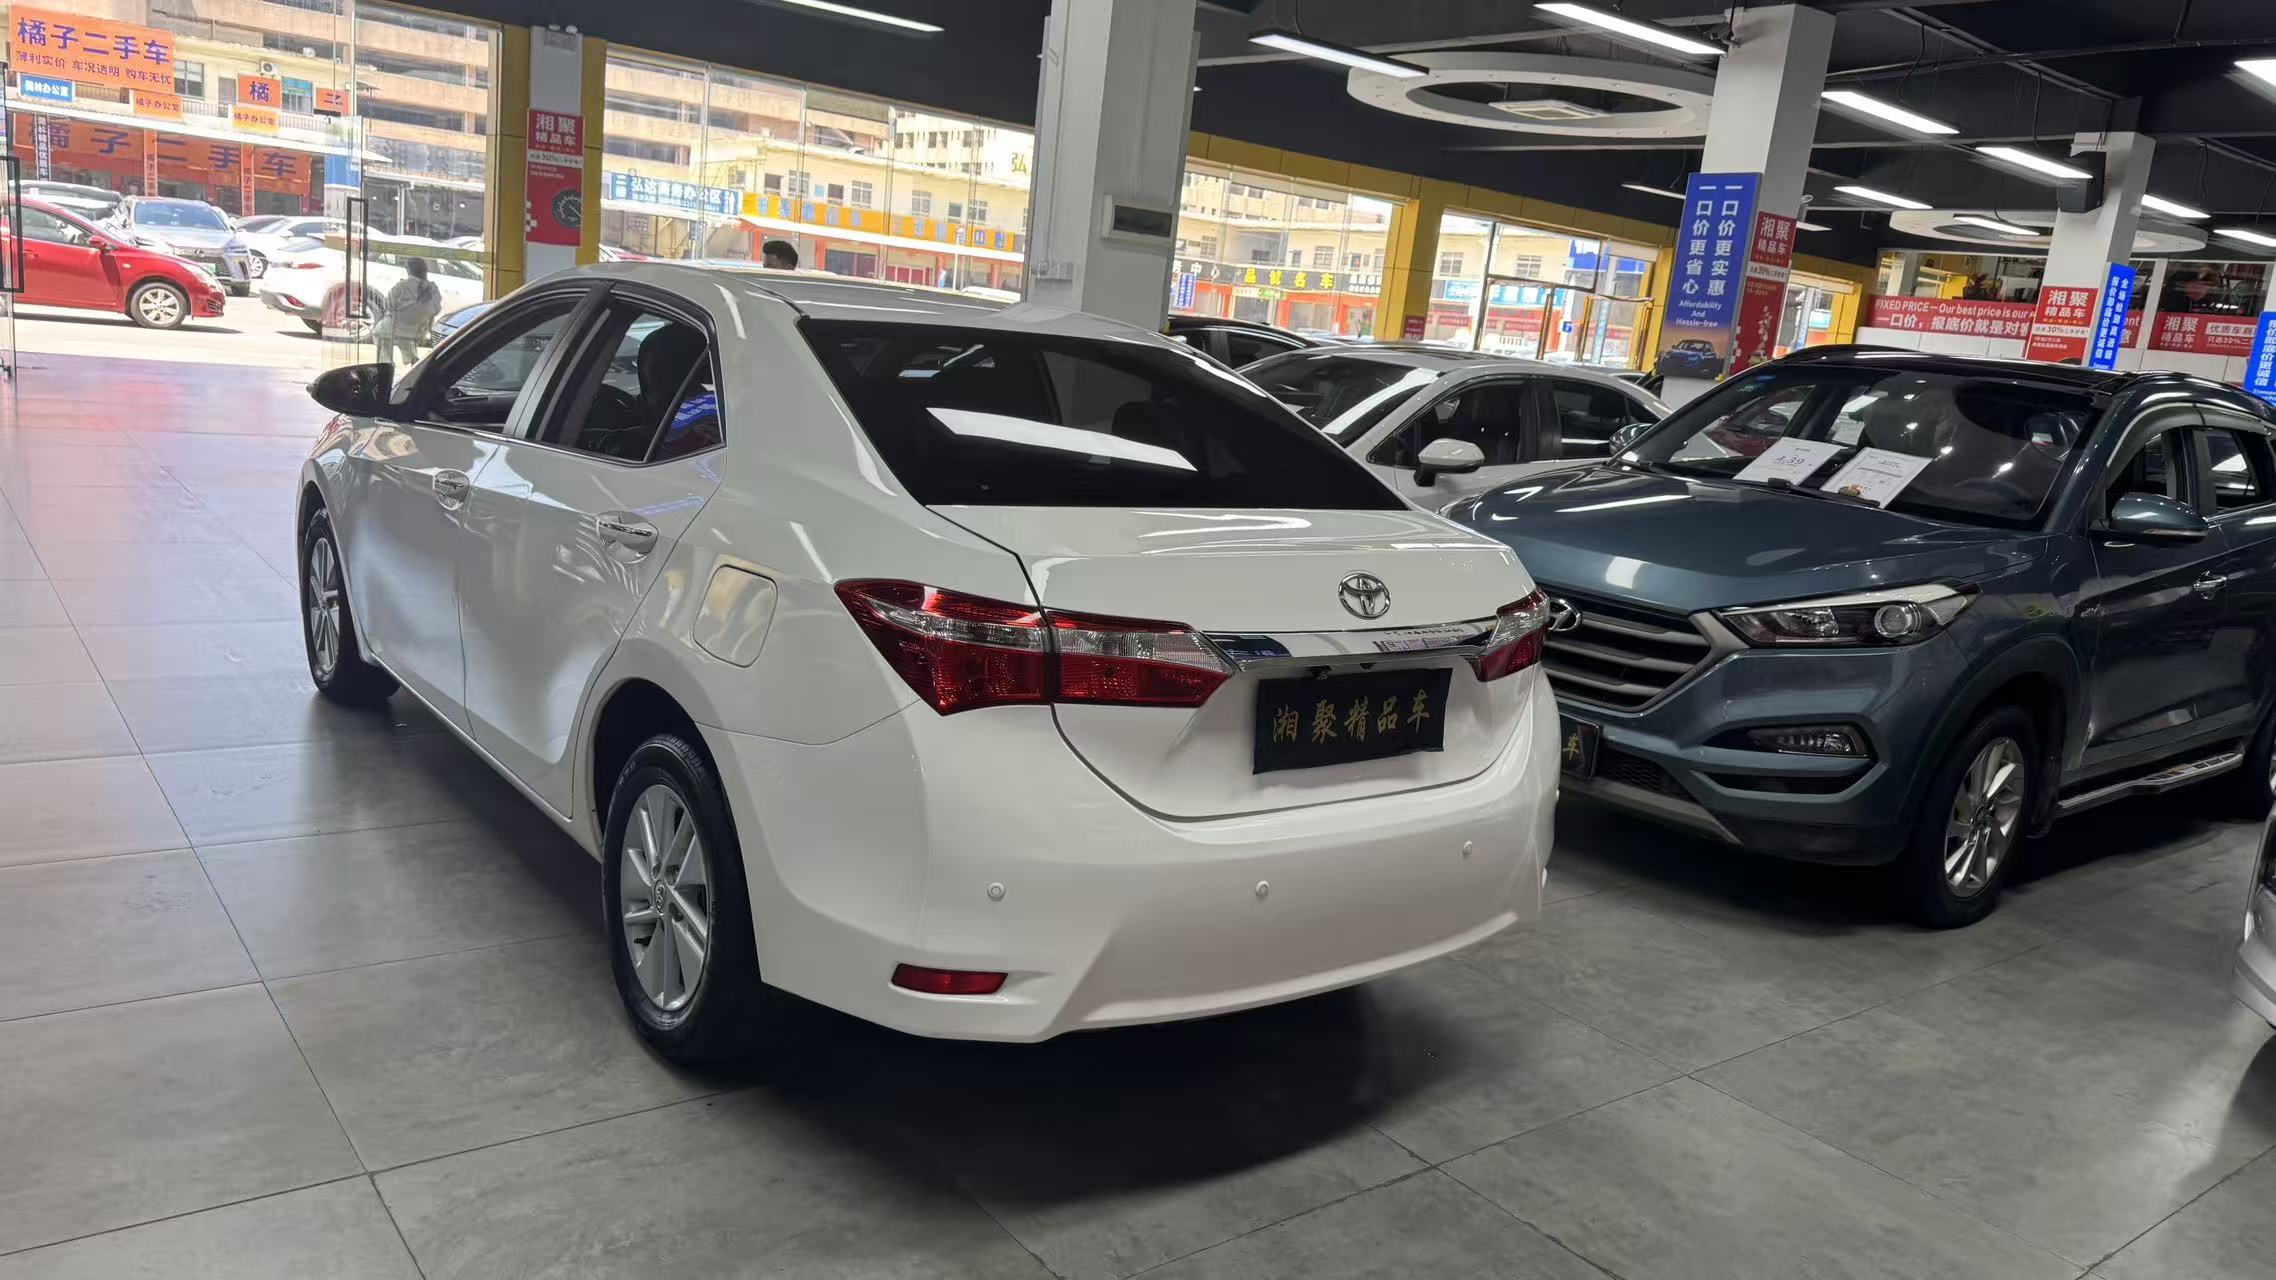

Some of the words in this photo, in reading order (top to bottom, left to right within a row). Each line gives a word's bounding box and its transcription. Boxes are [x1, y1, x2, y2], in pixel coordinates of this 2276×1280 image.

[17, 17, 170, 65] 橘子二手车
[72, 60, 120, 77] 车况透明
[126, 68, 171, 85] 购车无忧
[249, 81, 269, 102] 橘
[536, 112, 576, 135] 湘聚
[535, 131, 576, 146] 精品车
[1760, 216, 1790, 240] 湘聚
[1682, 185, 1717, 295] 一口价更省心
[1707, 185, 1743, 296] 一口价更实惠
[1679, 300, 1723, 311] Affordability
[2047, 289, 2089, 307] 湘聚
[1691, 310, 1706, 318] And
[1875, 299, 1901, 311] FIXED
[1902, 300, 1929, 313] PRICE
[1939, 303, 1956, 314] Our
[1957, 304, 1977, 316] best
[1977, 305, 2001, 319] price
[2002, 306, 2011, 318] is
[2012, 308, 2028, 319] our
[2044, 306, 2085, 318] 精品车
[2163, 315, 2200, 333] 湘聚
[2160, 331, 2196, 344] 精品车
[1272, 688, 1430, 744] 湘聚精品车
[1562, 733, 1580, 760] 车
